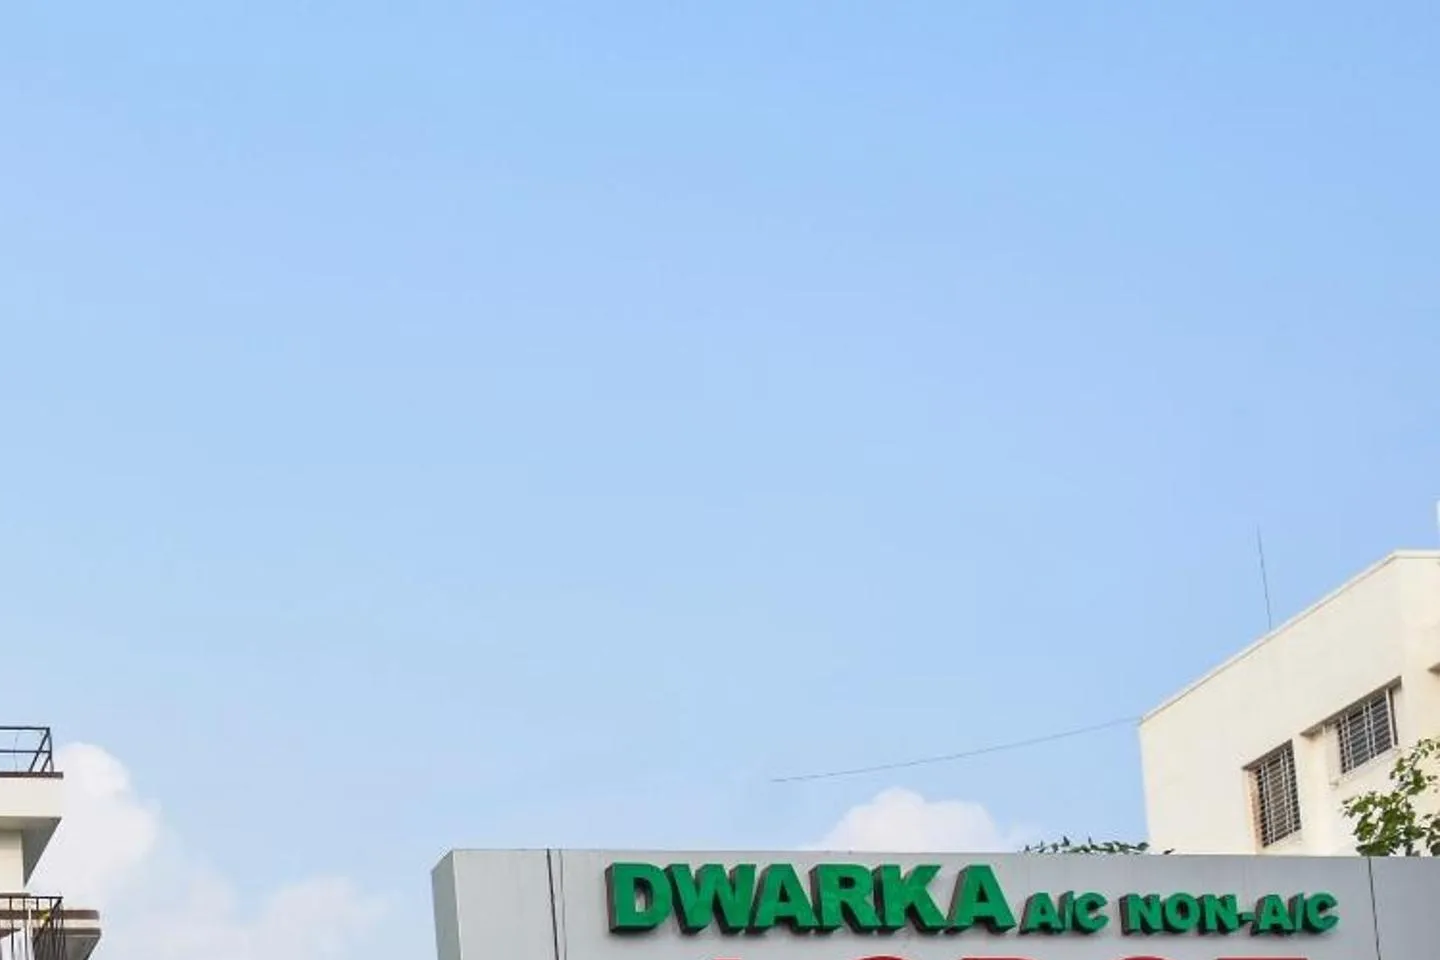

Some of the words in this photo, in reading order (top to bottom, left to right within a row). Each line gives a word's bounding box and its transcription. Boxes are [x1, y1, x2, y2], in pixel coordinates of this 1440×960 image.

[605, 862, 1016, 934] DWARKA
[1019, 890, 1109, 935] A/C
[1119, 892, 1340, 935] NON-A/C
